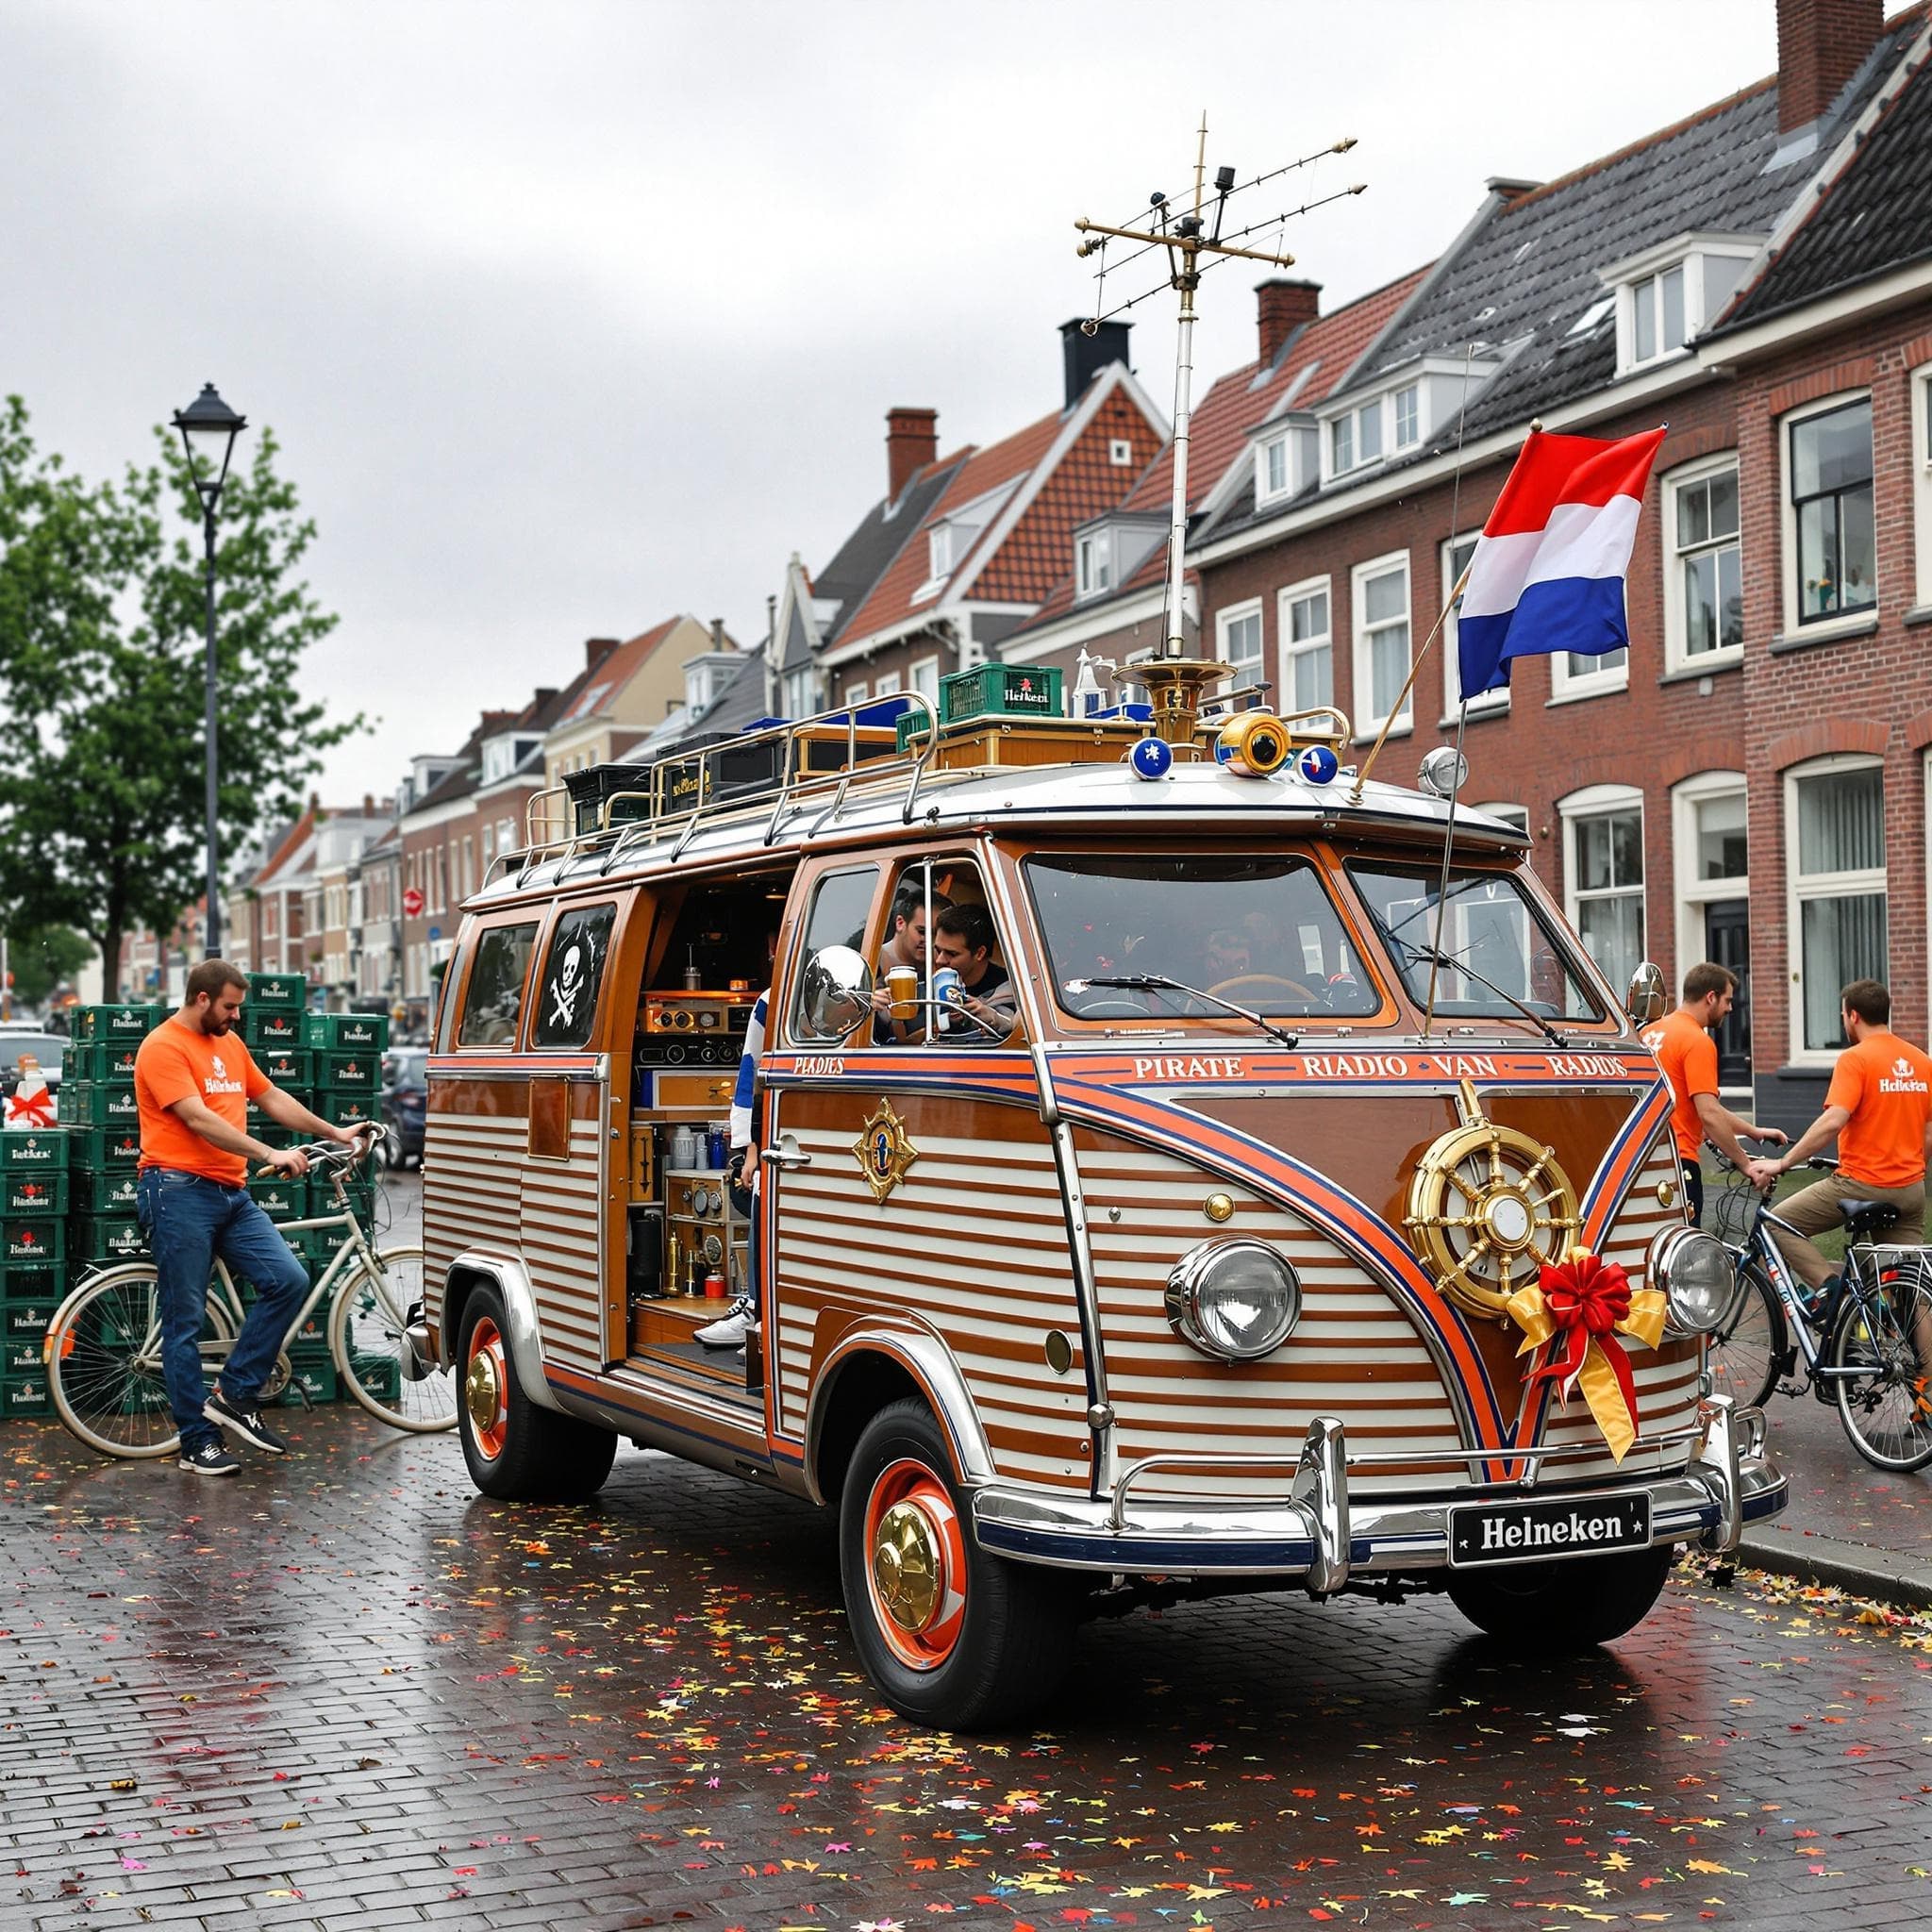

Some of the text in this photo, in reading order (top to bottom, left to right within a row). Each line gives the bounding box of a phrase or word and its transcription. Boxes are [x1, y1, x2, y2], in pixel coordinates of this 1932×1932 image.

[1133, 1057, 1245, 1078] PIRATE
[1300, 1055, 1408, 1077] RIADIO
[1430, 1055, 1500, 1077] VAN
